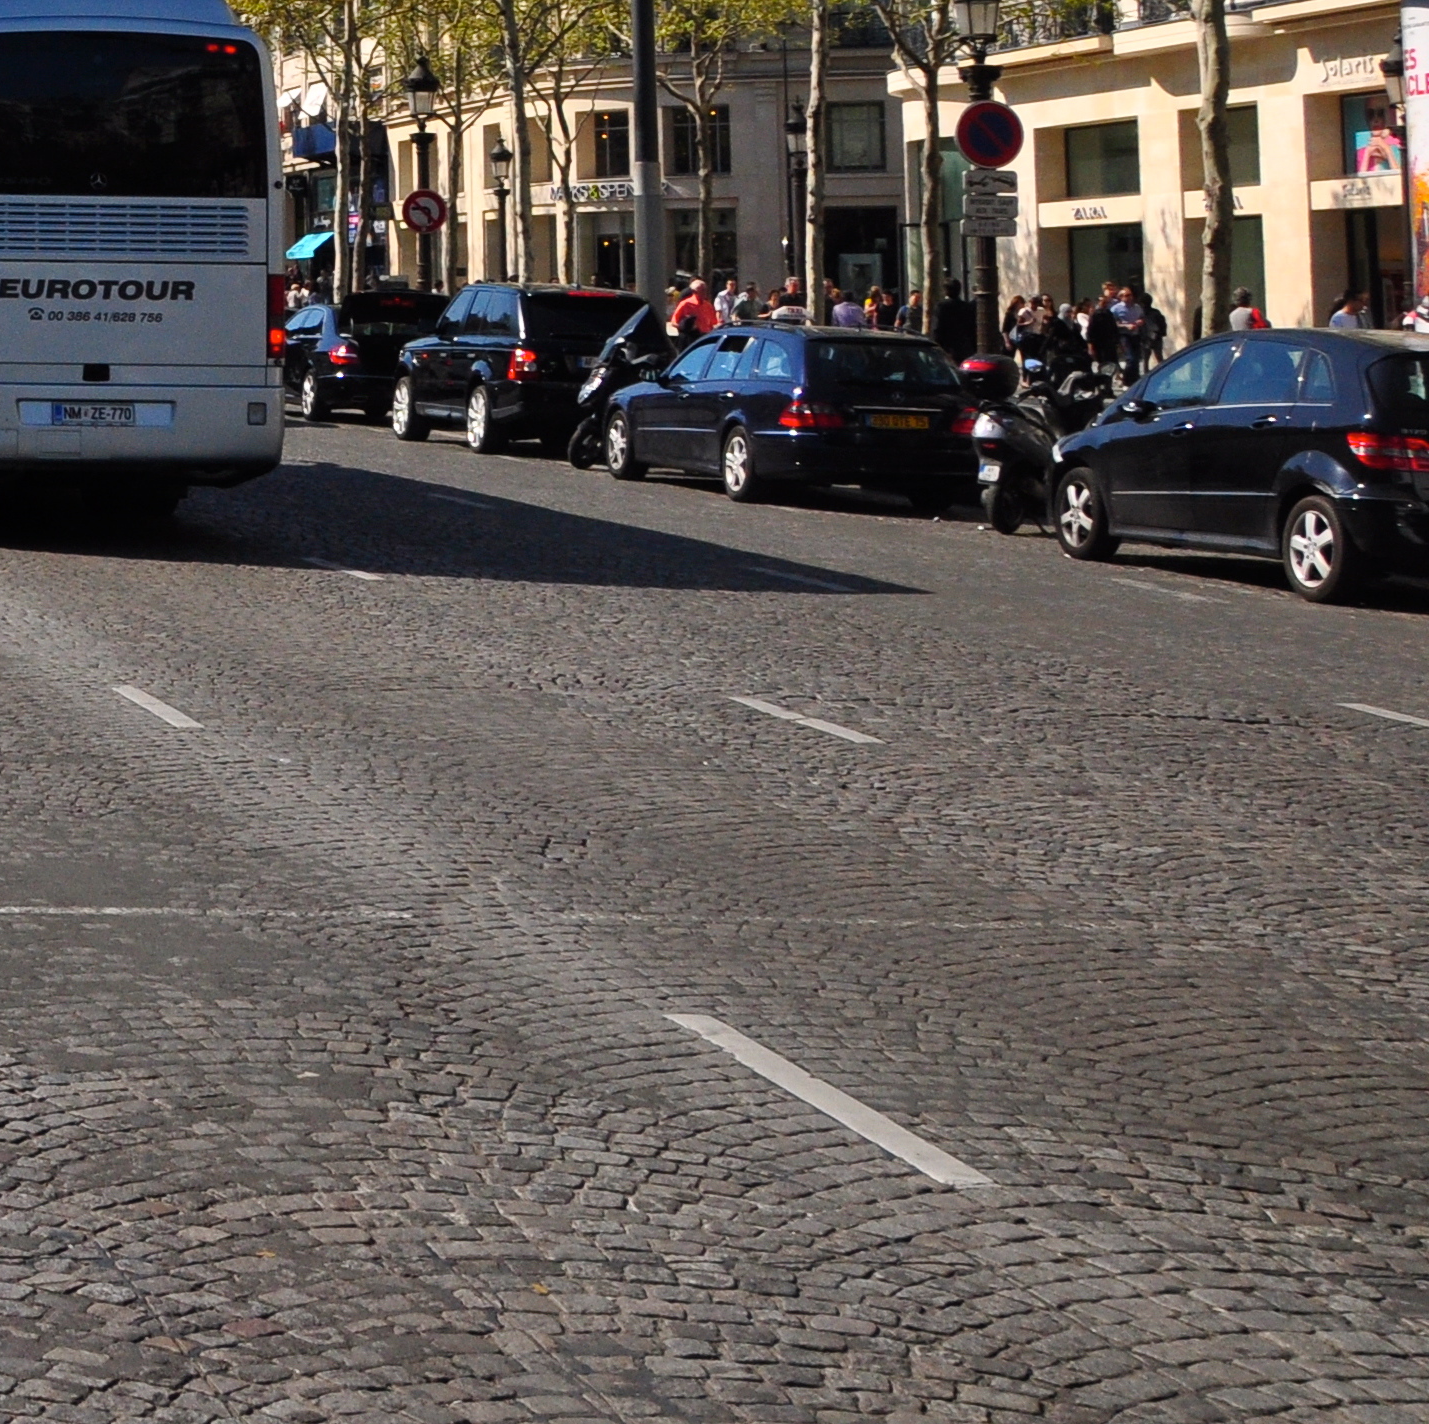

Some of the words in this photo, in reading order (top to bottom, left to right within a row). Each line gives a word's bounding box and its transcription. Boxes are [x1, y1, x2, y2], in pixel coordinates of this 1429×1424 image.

[48, 311, 64, 322] 00
[67, 311, 91, 322] 386
[94, 312, 136, 323] 41/628
[140, 313, 163, 323] 756
[63, 407, 82, 419] NM
[90, 407, 132, 421] ZE-770
